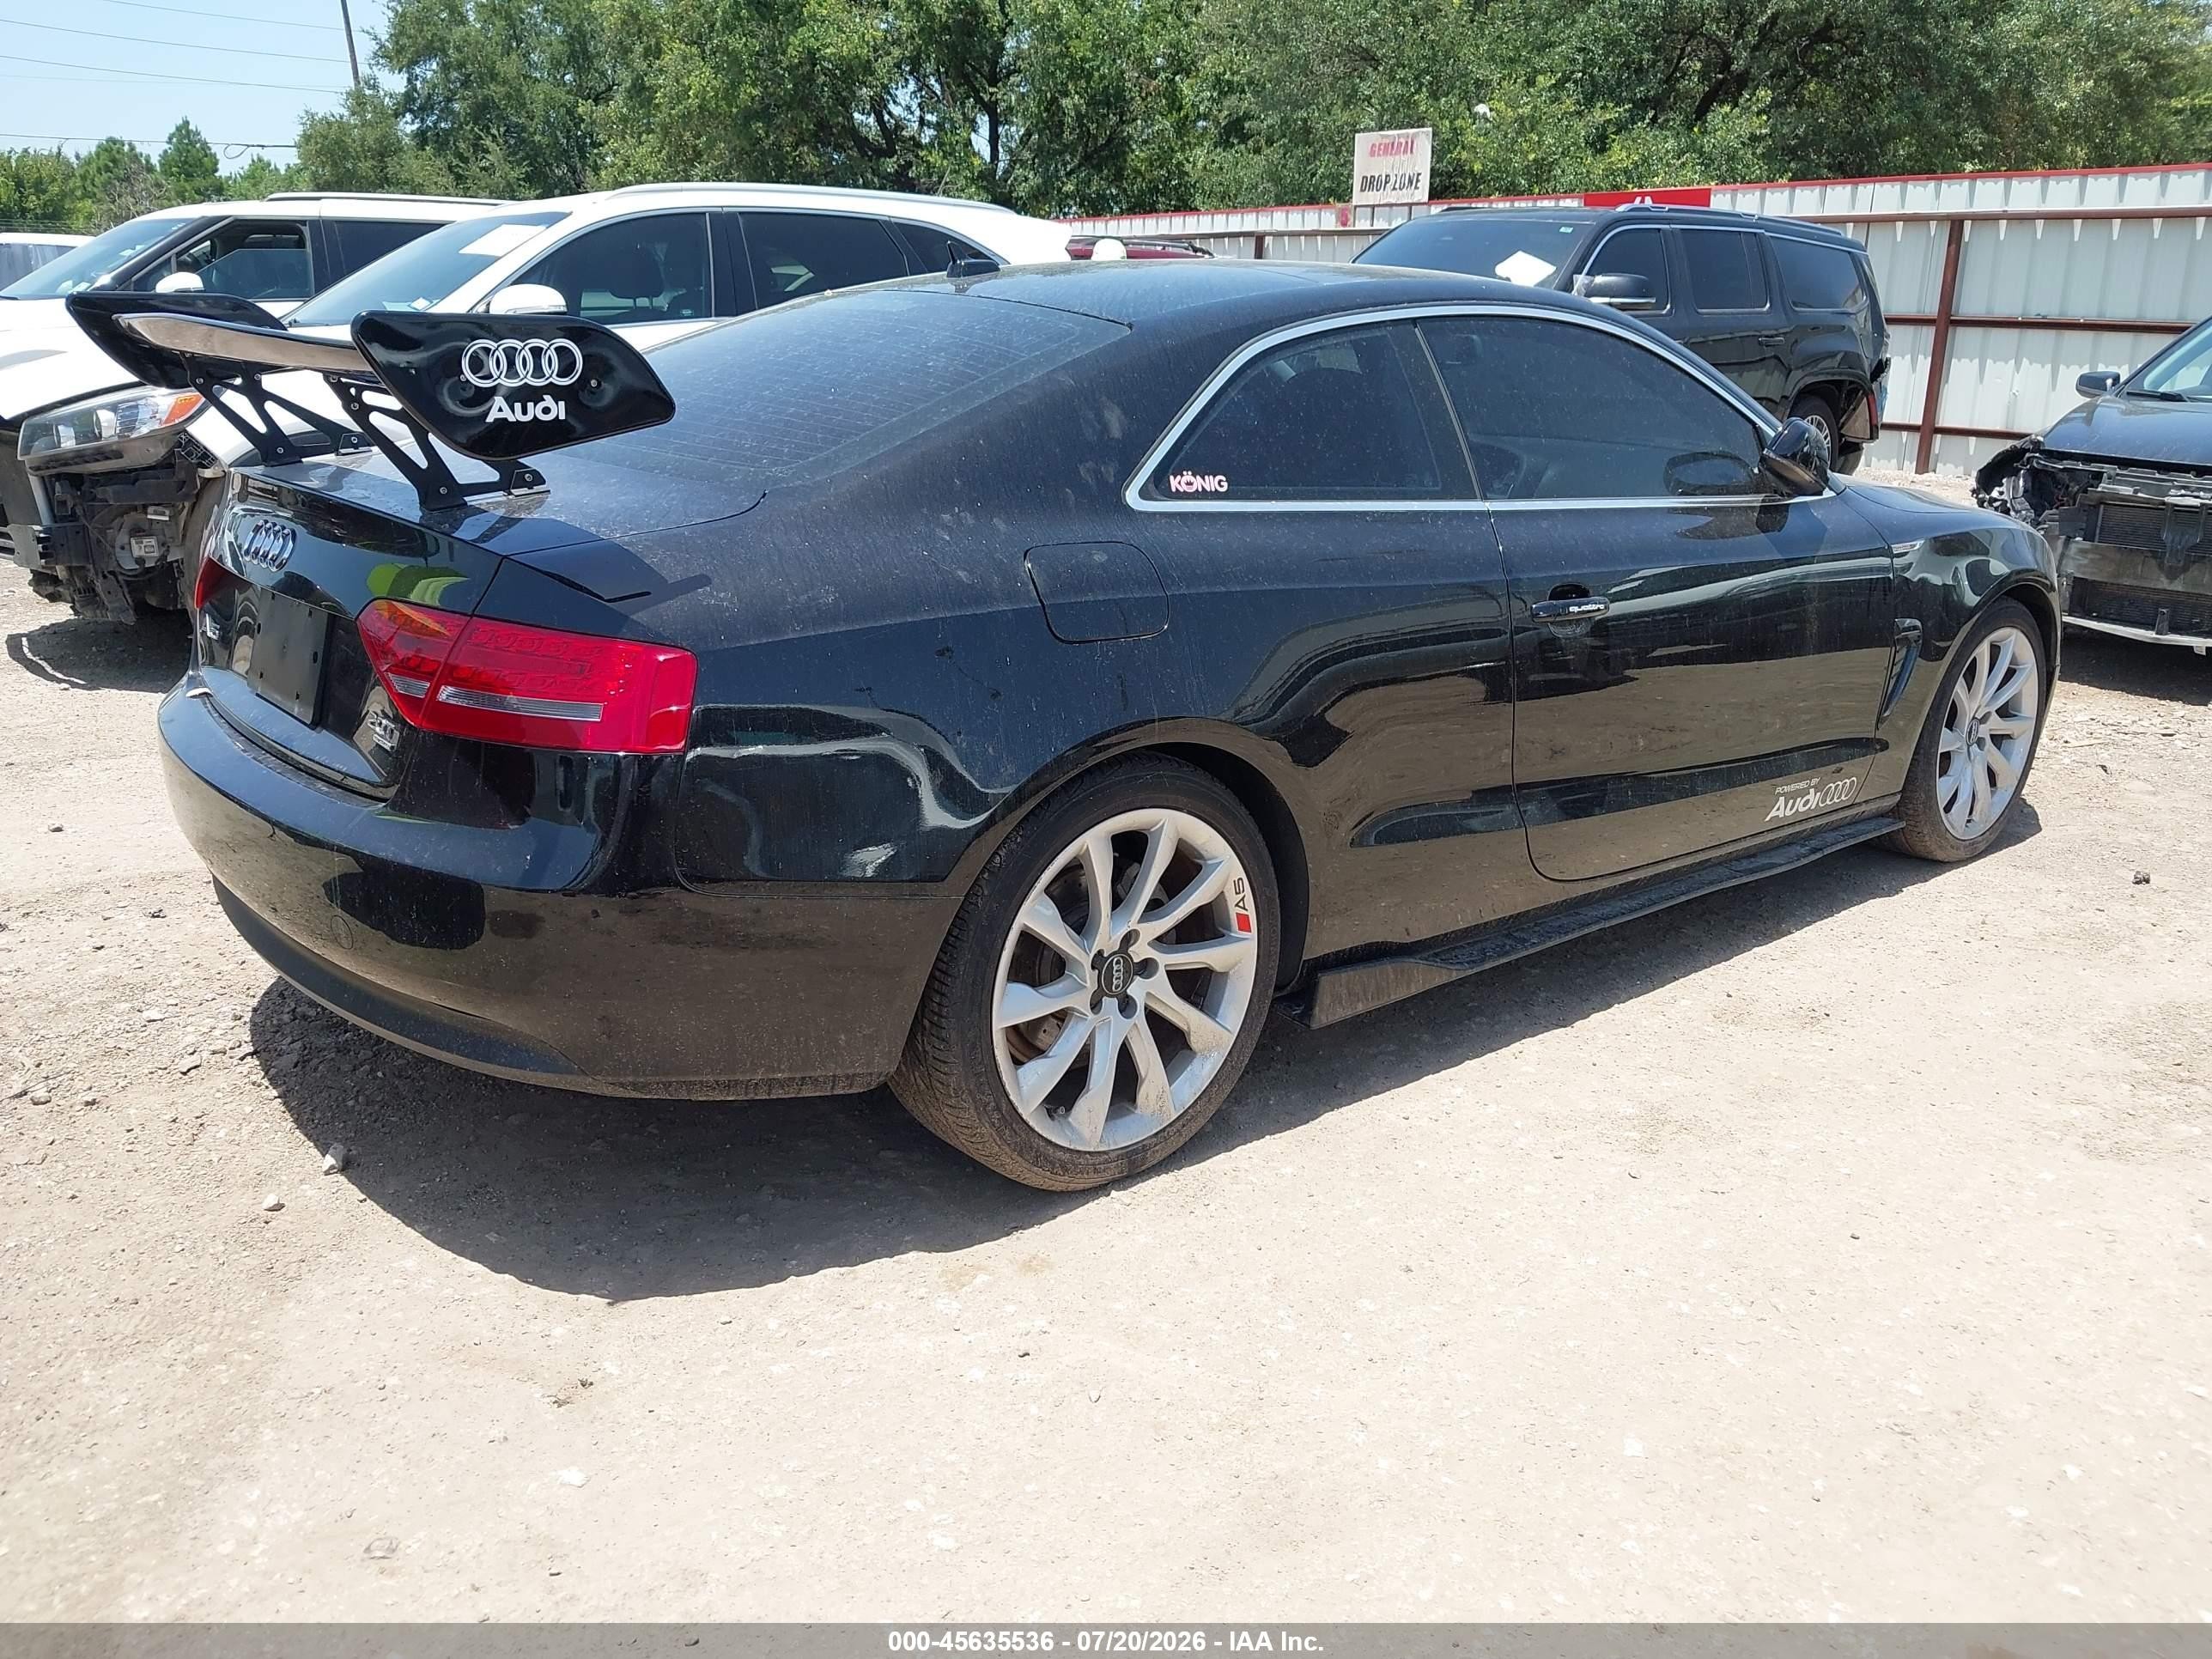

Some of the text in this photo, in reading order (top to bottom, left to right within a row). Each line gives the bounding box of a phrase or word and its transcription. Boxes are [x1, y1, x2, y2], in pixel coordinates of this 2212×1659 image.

[1359, 172, 1422, 192] DROP ZONE
[485, 394, 566, 422] Audi
[1170, 471, 1229, 493] KÖNIG
[1569, 604, 1605, 613] quattro
[1774, 776, 1821, 795] POWERED BY
[1764, 787, 1821, 822] Audi
[1233, 877, 1249, 912] A5
